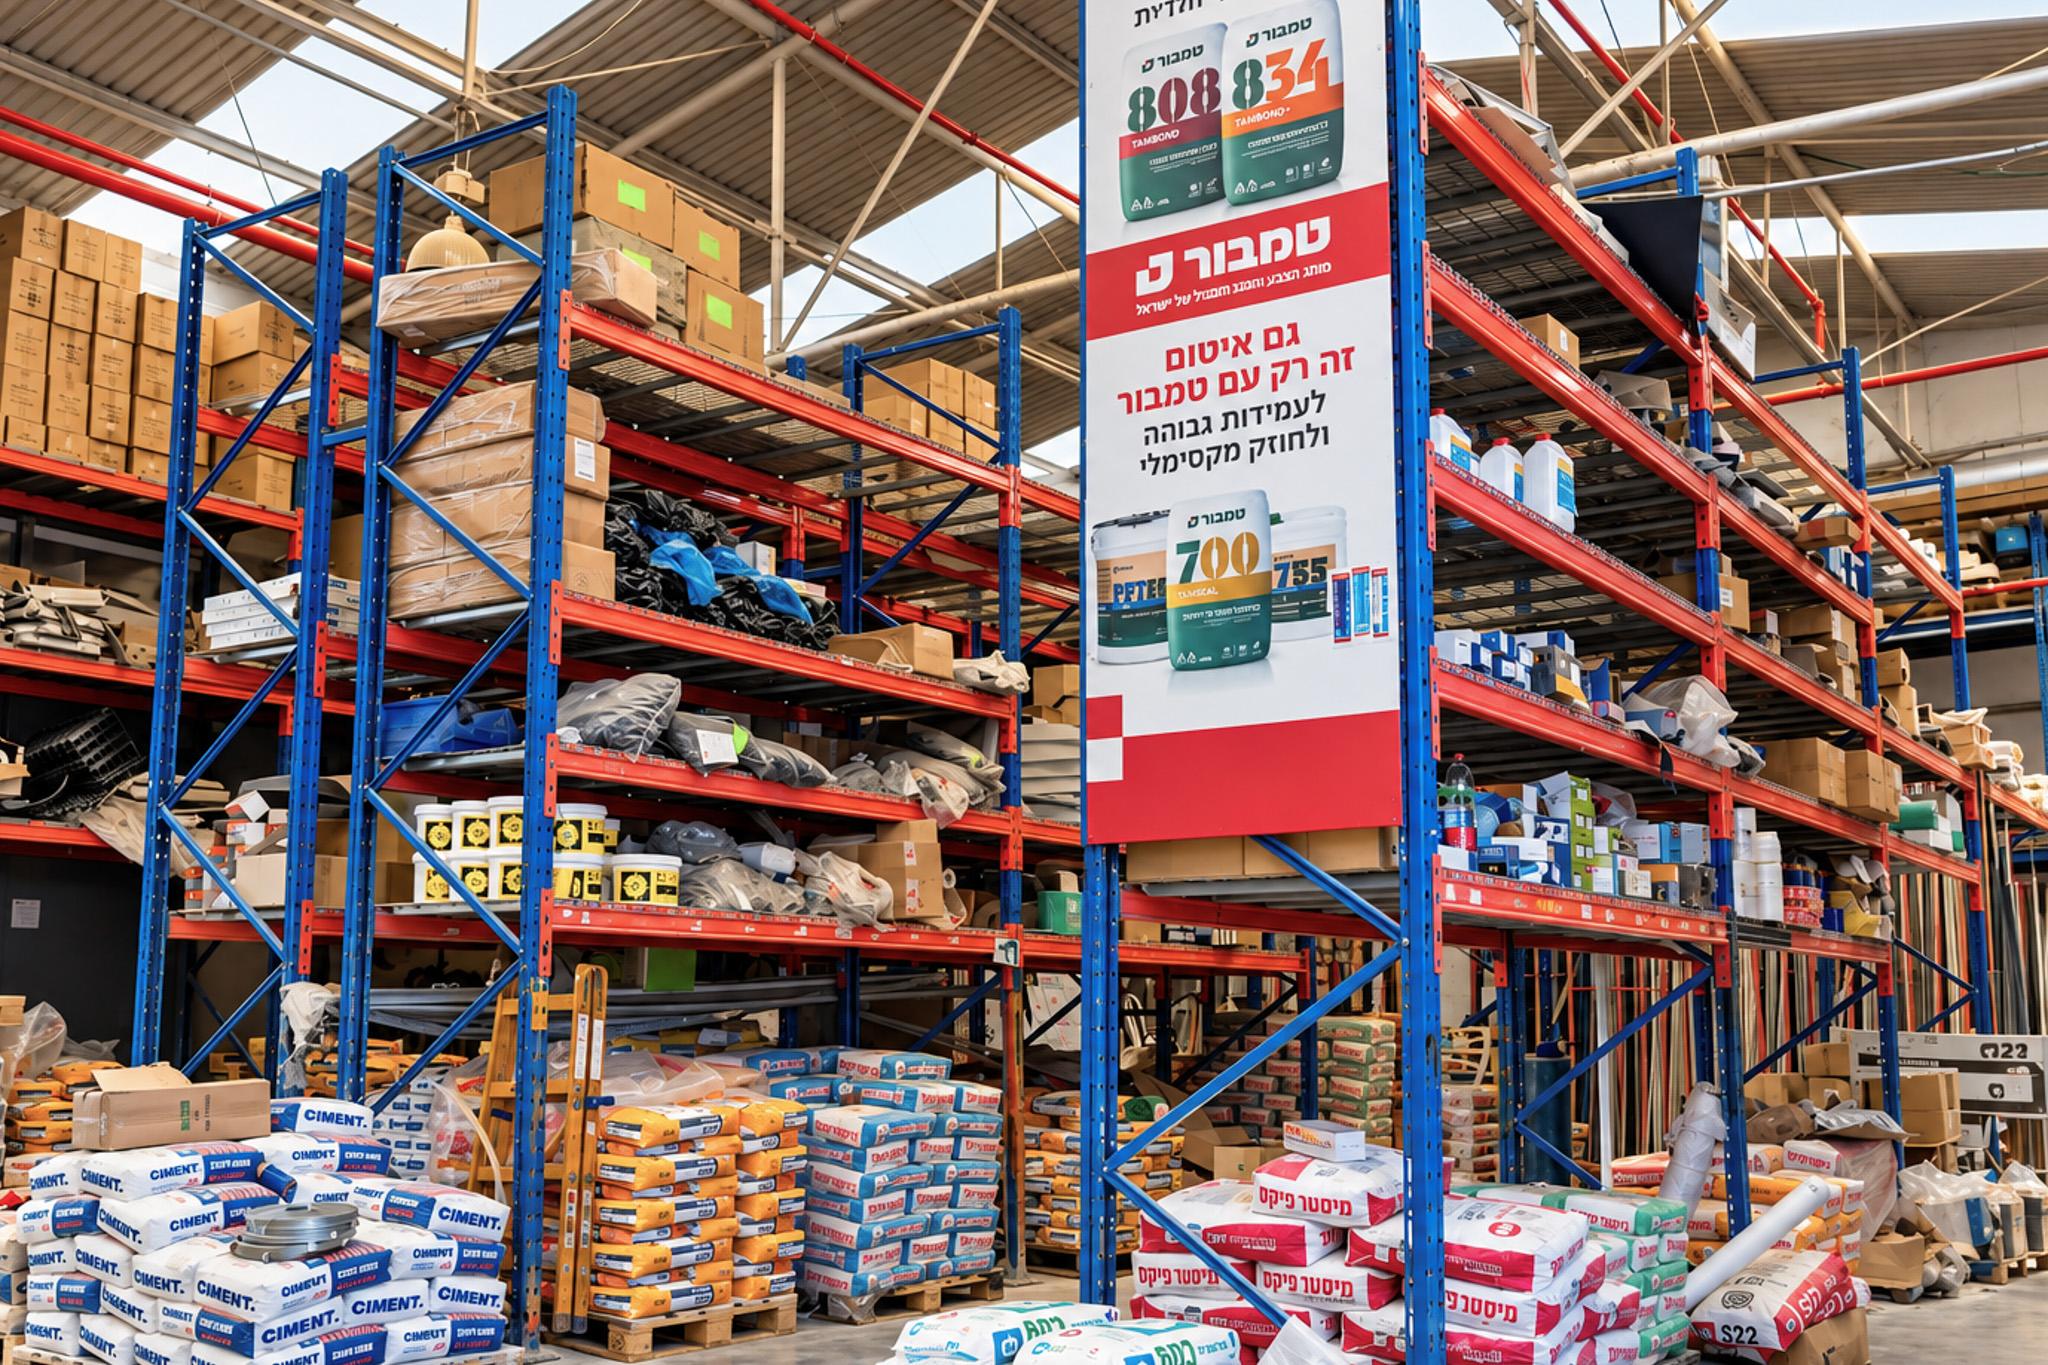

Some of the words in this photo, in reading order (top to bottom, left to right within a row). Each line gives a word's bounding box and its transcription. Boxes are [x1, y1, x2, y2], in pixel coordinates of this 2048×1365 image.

[1232, 38, 1331, 110] 834
[1127, 67, 1221, 133] 808
[1183, 216, 1331, 280] טמבור
[1136, 298, 1173, 316] ישראל
[1174, 293, 1192, 306] של
[1263, 322, 1300, 351] גם
[1166, 332, 1253, 372] איטום
[1320, 346, 1356, 376] זה
[1219, 365, 1260, 397] עם
[1271, 358, 1309, 392] רק
[1117, 376, 1208, 415] טמבור
[1221, 388, 1327, 432] לעמידות
[1144, 415, 1213, 446] גבוהה
[1249, 422, 1330, 464] ולחוזק
[1140, 440, 1241, 476] מקסימלי
[1201, 507, 1246, 525] טמבור
[1176, 532, 1260, 585] 700
[1274, 556, 1328, 588] 755
[304, 1109, 367, 1128] CIMENT.
[150, 1163, 199, 1180] CIMENT
[1259, 1186, 1295, 1209] פיקס
[1298, 1196, 1352, 1216] מיסטר
[170, 1211, 219, 1232] CIMENT
[438, 1206, 501, 1230] CIMENT.
[75, 1249, 121, 1277] CIMENT.
[1138, 1266, 1172, 1288] פיקס
[134, 1269, 185, 1294] CIMENT.
[1263, 1271, 1298, 1293] פיקס
[1300, 1276, 1353, 1297] מיסטר
[197, 1280, 255, 1312] CIMENT.
[352, 1294, 424, 1315] CIMENT.
[438, 1286, 501, 1308] CIMENT.
[261, 1309, 340, 1344] CIMENT.
[1721, 1324, 1758, 1345] S22
